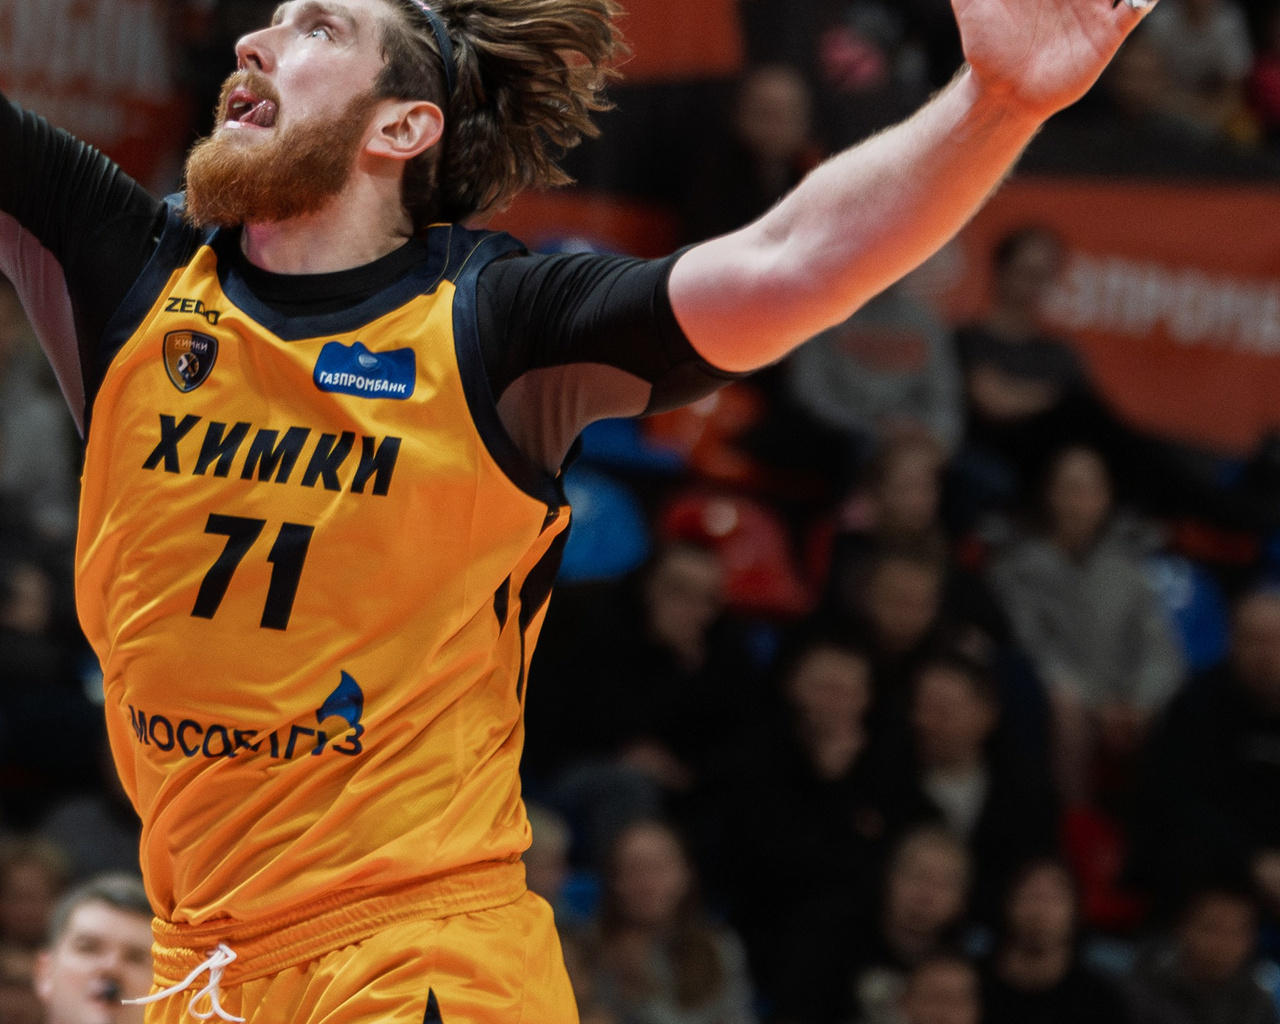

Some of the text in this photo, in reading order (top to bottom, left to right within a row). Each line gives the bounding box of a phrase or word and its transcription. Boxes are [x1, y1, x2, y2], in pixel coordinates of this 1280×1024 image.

[319, 371, 406, 394] ГАЗПРОМБАНК
[142, 413, 402, 497] ХИМКИ
[191, 513, 316, 631] 71
